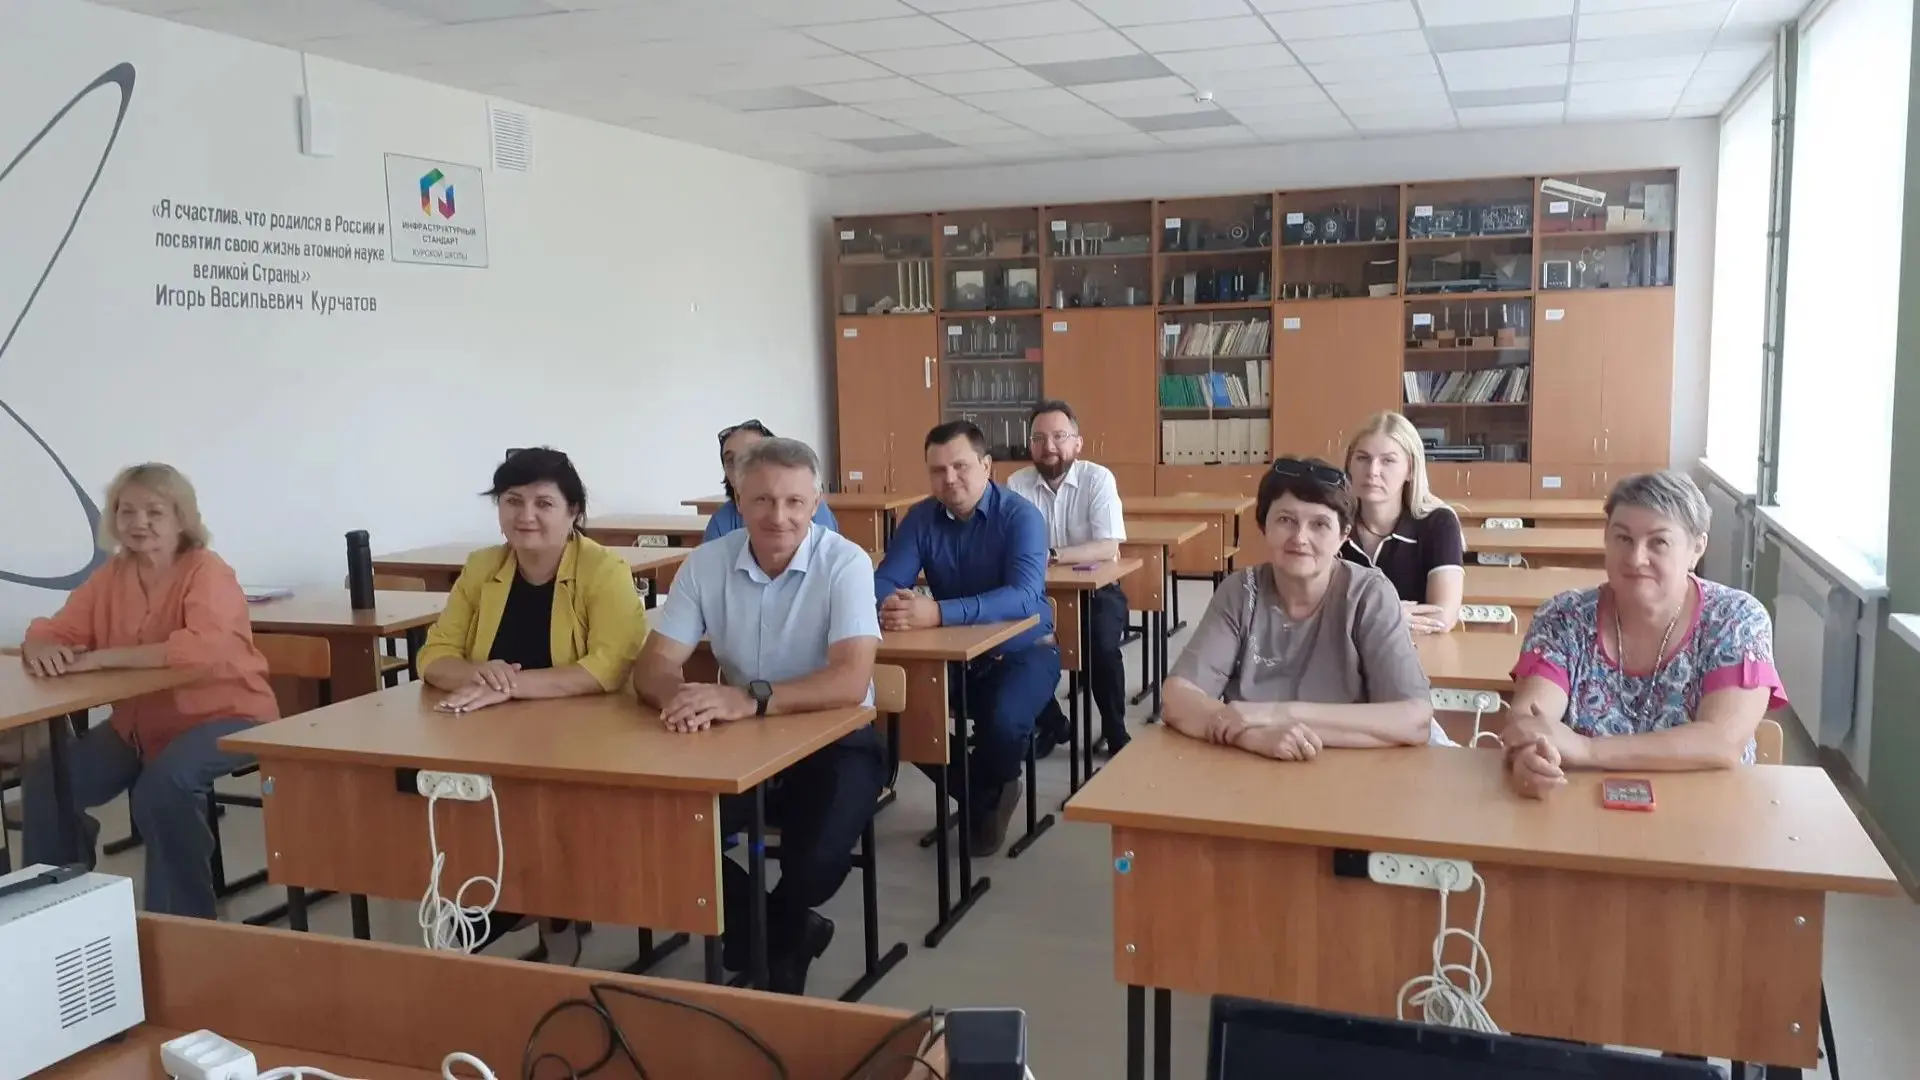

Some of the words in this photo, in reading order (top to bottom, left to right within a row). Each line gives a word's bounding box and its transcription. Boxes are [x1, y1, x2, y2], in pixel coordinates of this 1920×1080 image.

[152, 199, 171, 218] «Я
[245, 211, 266, 227] что
[270, 213, 322, 232] родился
[325, 219, 332, 232] в
[335, 215, 375, 235] России
[378, 222, 385, 235] и
[402, 221, 476, 236] ИНФРАСТРУКТУРНЫЙ
[155, 231, 221, 252] посвятил
[224, 237, 259, 253] свою
[262, 241, 301, 256] жизнь
[303, 244, 352, 259] атомной
[354, 246, 385, 263] науке
[424, 236, 457, 245] СТАНДАРТ
[193, 262, 248, 281] великой
[252, 263, 311, 285] Страны»
[155, 284, 205, 310] Игорь
[211, 286, 303, 310] Васильевич
[311, 290, 377, 315] Курчатов
